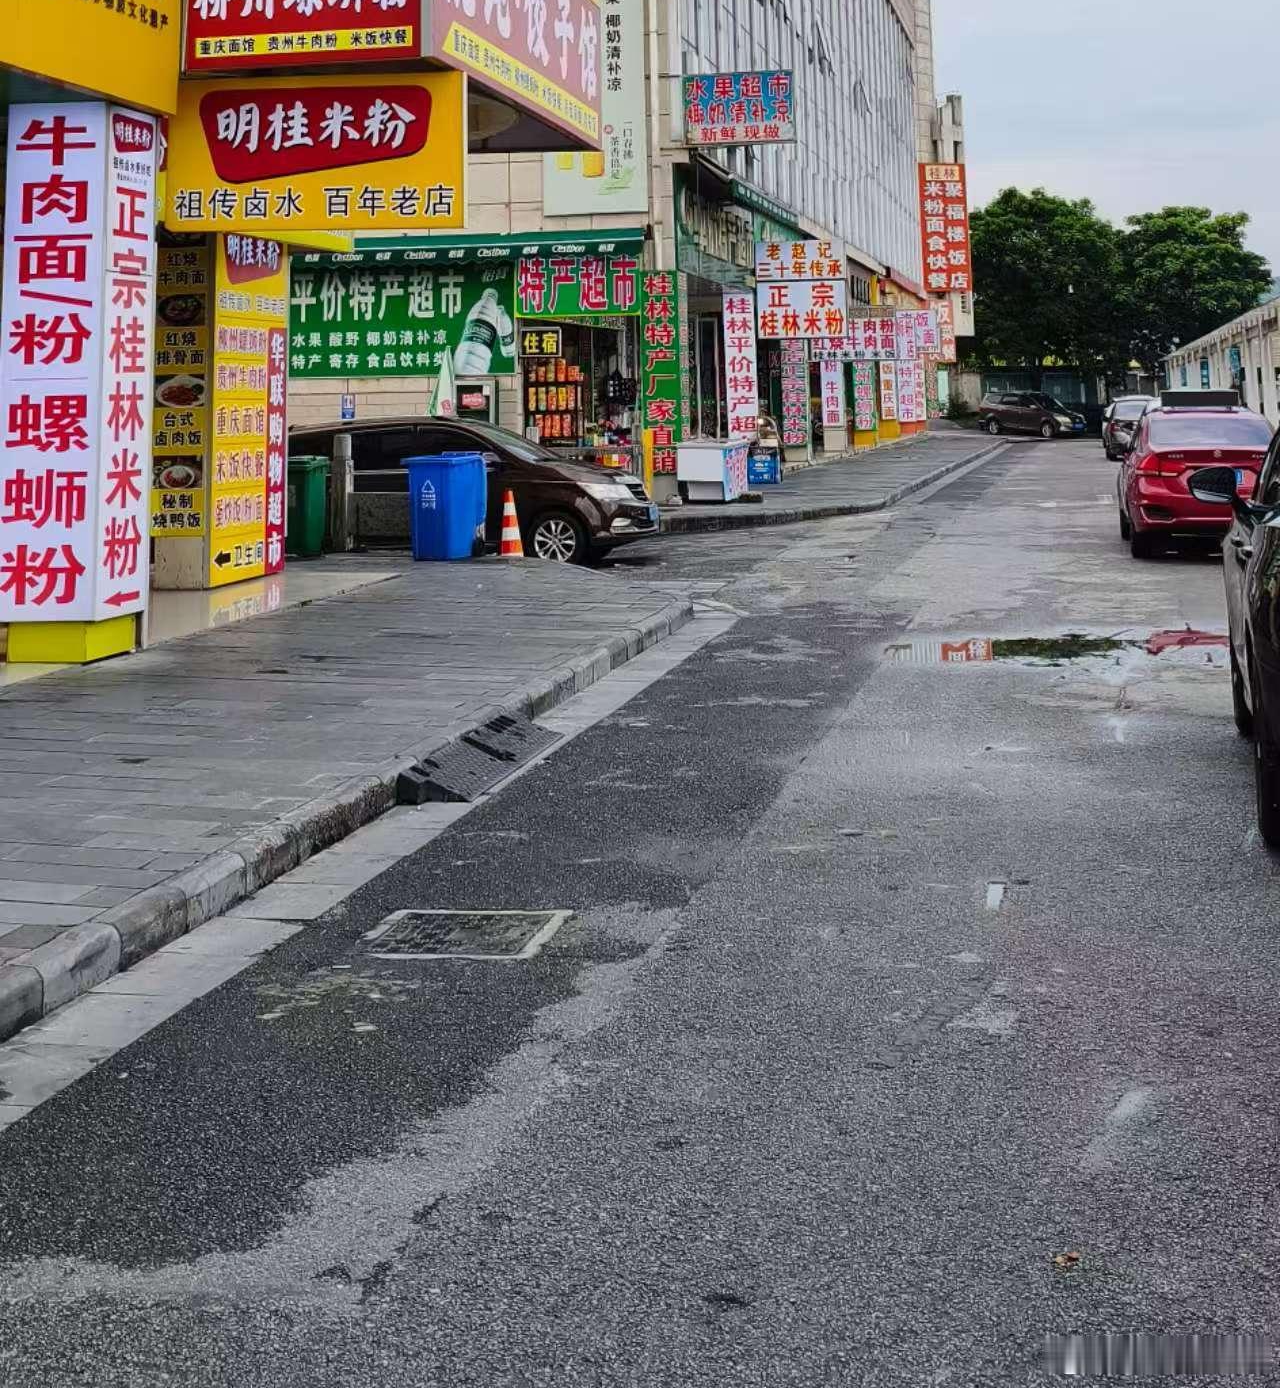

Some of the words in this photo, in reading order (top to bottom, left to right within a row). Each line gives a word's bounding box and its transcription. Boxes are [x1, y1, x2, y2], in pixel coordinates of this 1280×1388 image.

[199, 38, 255, 55] 重庆面馆
[267, 32, 337, 51] 贵州牛肉粉
[350, 29, 408, 46] 米饭快餐
[606, 14, 622, 92] 椰奶清补凉
[686, 73, 790, 101] 水果超市
[114, 121, 151, 149] 明桂米粉
[215, 96, 418, 154] 明桂米粉
[700, 125, 736, 141] 新鲜
[744, 123, 780, 139] 现做
[175, 187, 304, 220] 祖传卤水
[323, 184, 456, 218] 百年老店
[924, 182, 949, 288] 米粉面食快餐
[945, 182, 968, 288] 聚福楼饭店
[167, 252, 198, 267] 红烧
[227, 234, 280, 270] 明桂米粉
[766, 242, 832, 260] 老赵记
[158, 270, 205, 285] 牛肉面
[757, 259, 842, 278] 三十年传承
[291, 268, 465, 323] 平价特产超市
[518, 256, 637, 312] 特产超市
[768, 282, 834, 308] 正宗
[760, 308, 844, 336] 桂林米粉
[165, 331, 197, 346] 红烧
[292, 331, 322, 347] 水果
[366, 329, 447, 346] 椰奶清补凉
[524, 332, 558, 354] 住宿
[156, 350, 204, 365] 排骨面
[291, 353, 322, 369] 特产
[329, 353, 359, 369] 寄存
[366, 351, 447, 369] 食品饮料类
[725, 297, 756, 441] 桂林平价特产超
[103, 185, 149, 580] 正宗桂林米粉
[217, 364, 266, 390] 贵州牛肉粉
[644, 273, 677, 474] 桂林特产厂家直销
[898, 360, 913, 420] 特产超市
[163, 412, 194, 427] 台式
[216, 406, 264, 435] 重庆面馆
[155, 431, 202, 446] 卤肉饭
[268, 332, 285, 567] 华联购物超市
[216, 450, 264, 483] 米饭快餐
[161, 493, 193, 509] 秘制
[152, 513, 200, 528] 烧鸭饭
[233, 541, 264, 567] 卫生间
